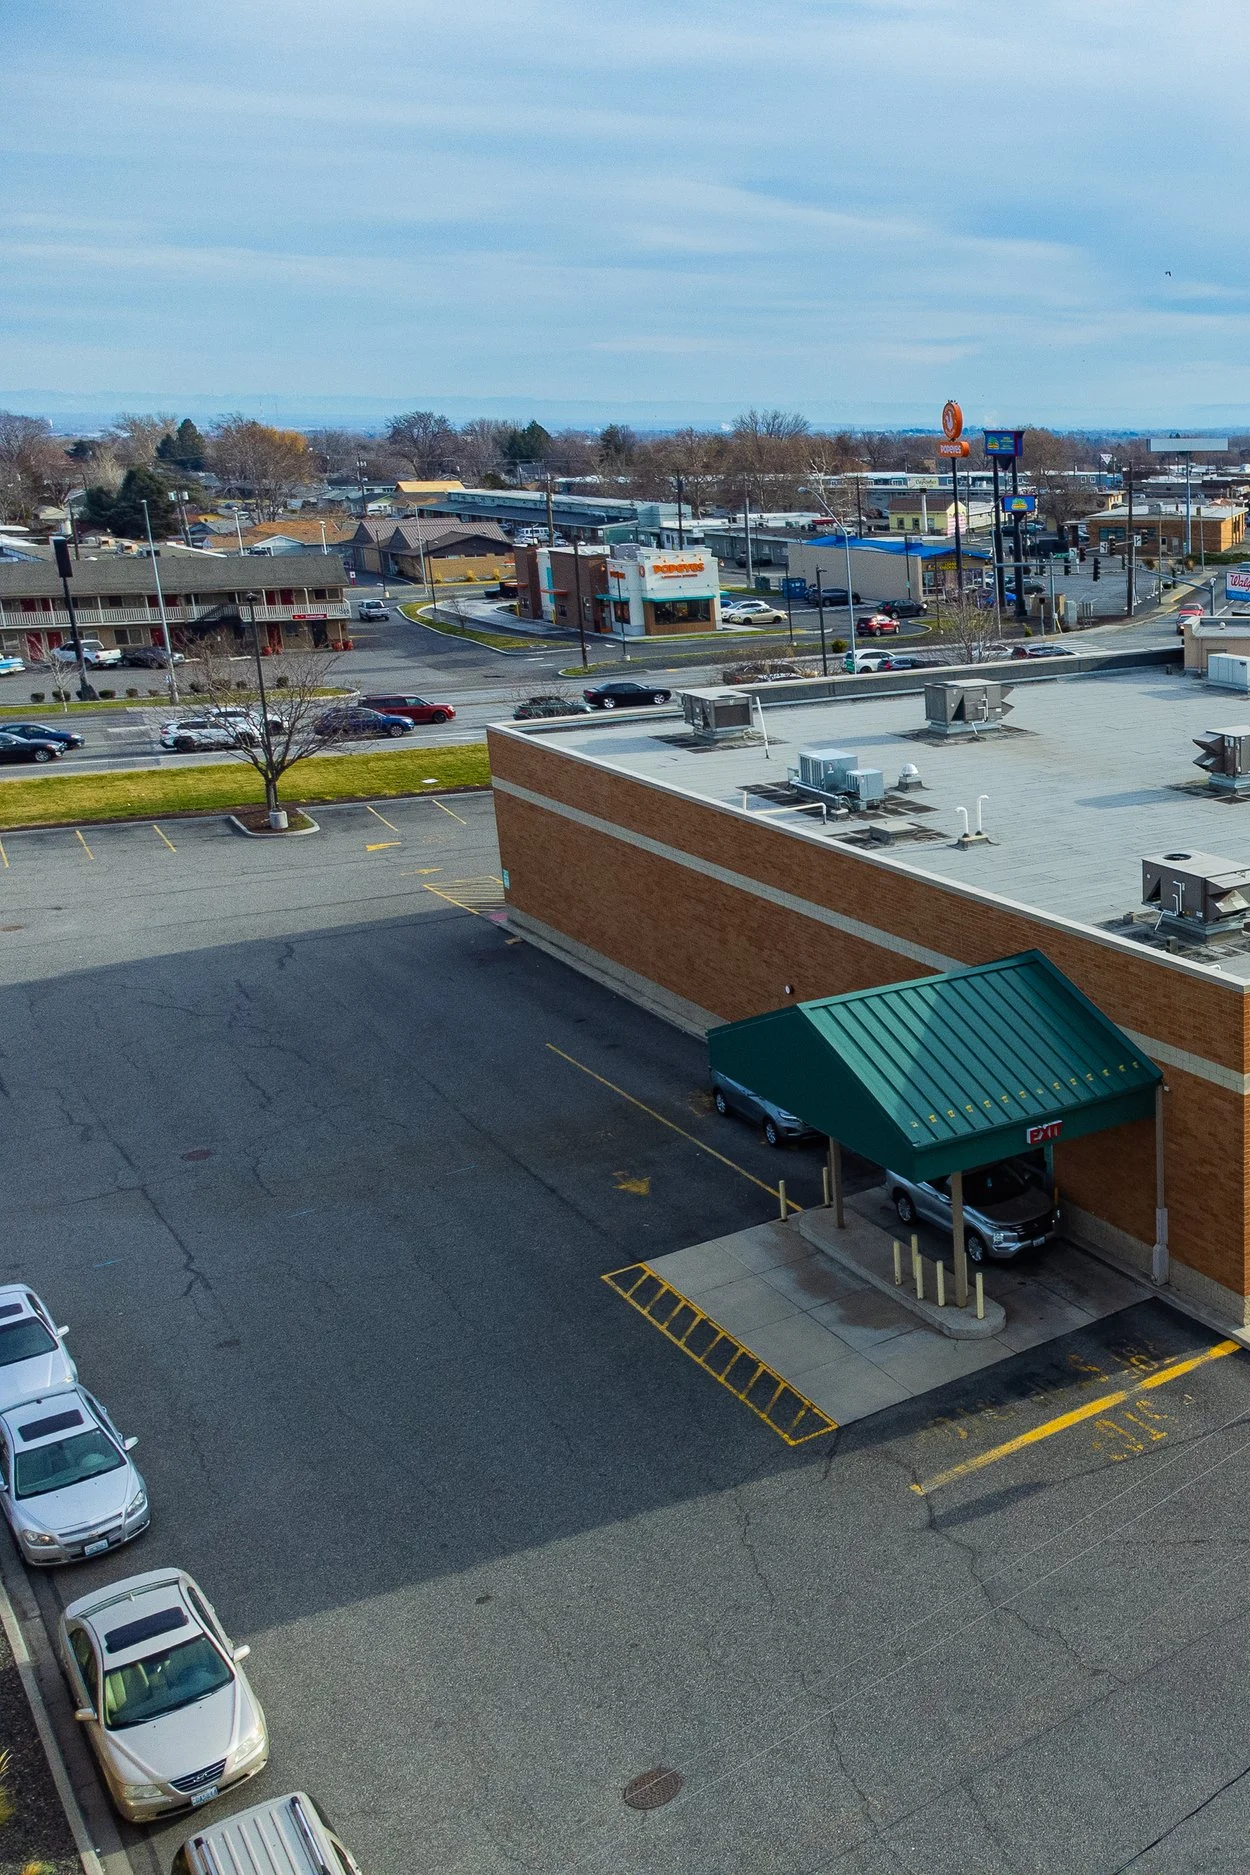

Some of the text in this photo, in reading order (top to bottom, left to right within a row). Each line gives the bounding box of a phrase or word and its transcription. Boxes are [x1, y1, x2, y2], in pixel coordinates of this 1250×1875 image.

[939, 444, 961, 454] POPEYES
[652, 562, 705, 575] POPEYES
[1028, 1121, 1064, 1145] EXIT
